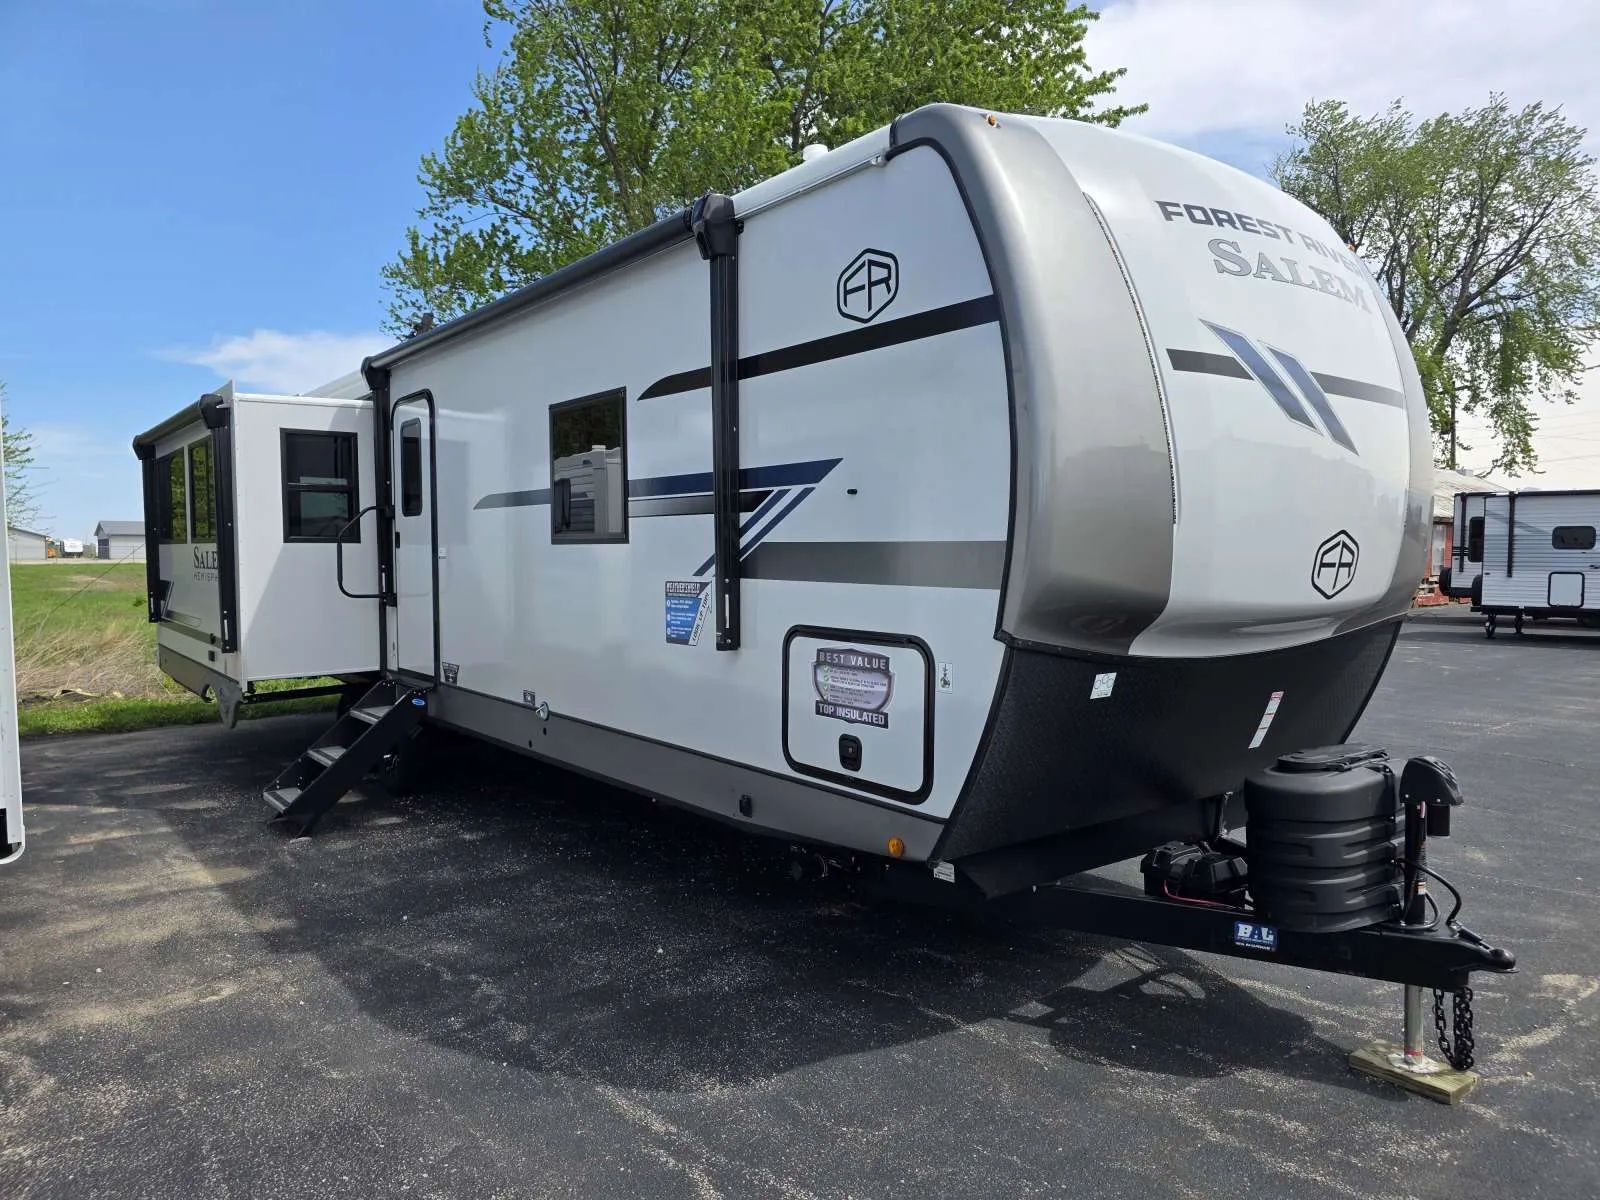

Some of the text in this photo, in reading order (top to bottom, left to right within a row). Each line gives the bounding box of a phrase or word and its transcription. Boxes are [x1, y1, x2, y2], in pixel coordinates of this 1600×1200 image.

[1154, 200, 1294, 244] FOREST
[1207, 238, 1372, 314] SALEM
[193, 546, 220, 570] SALE
[819, 651, 887, 670] BEST VALUE
[818, 703, 885, 725] TOP INSULATED
